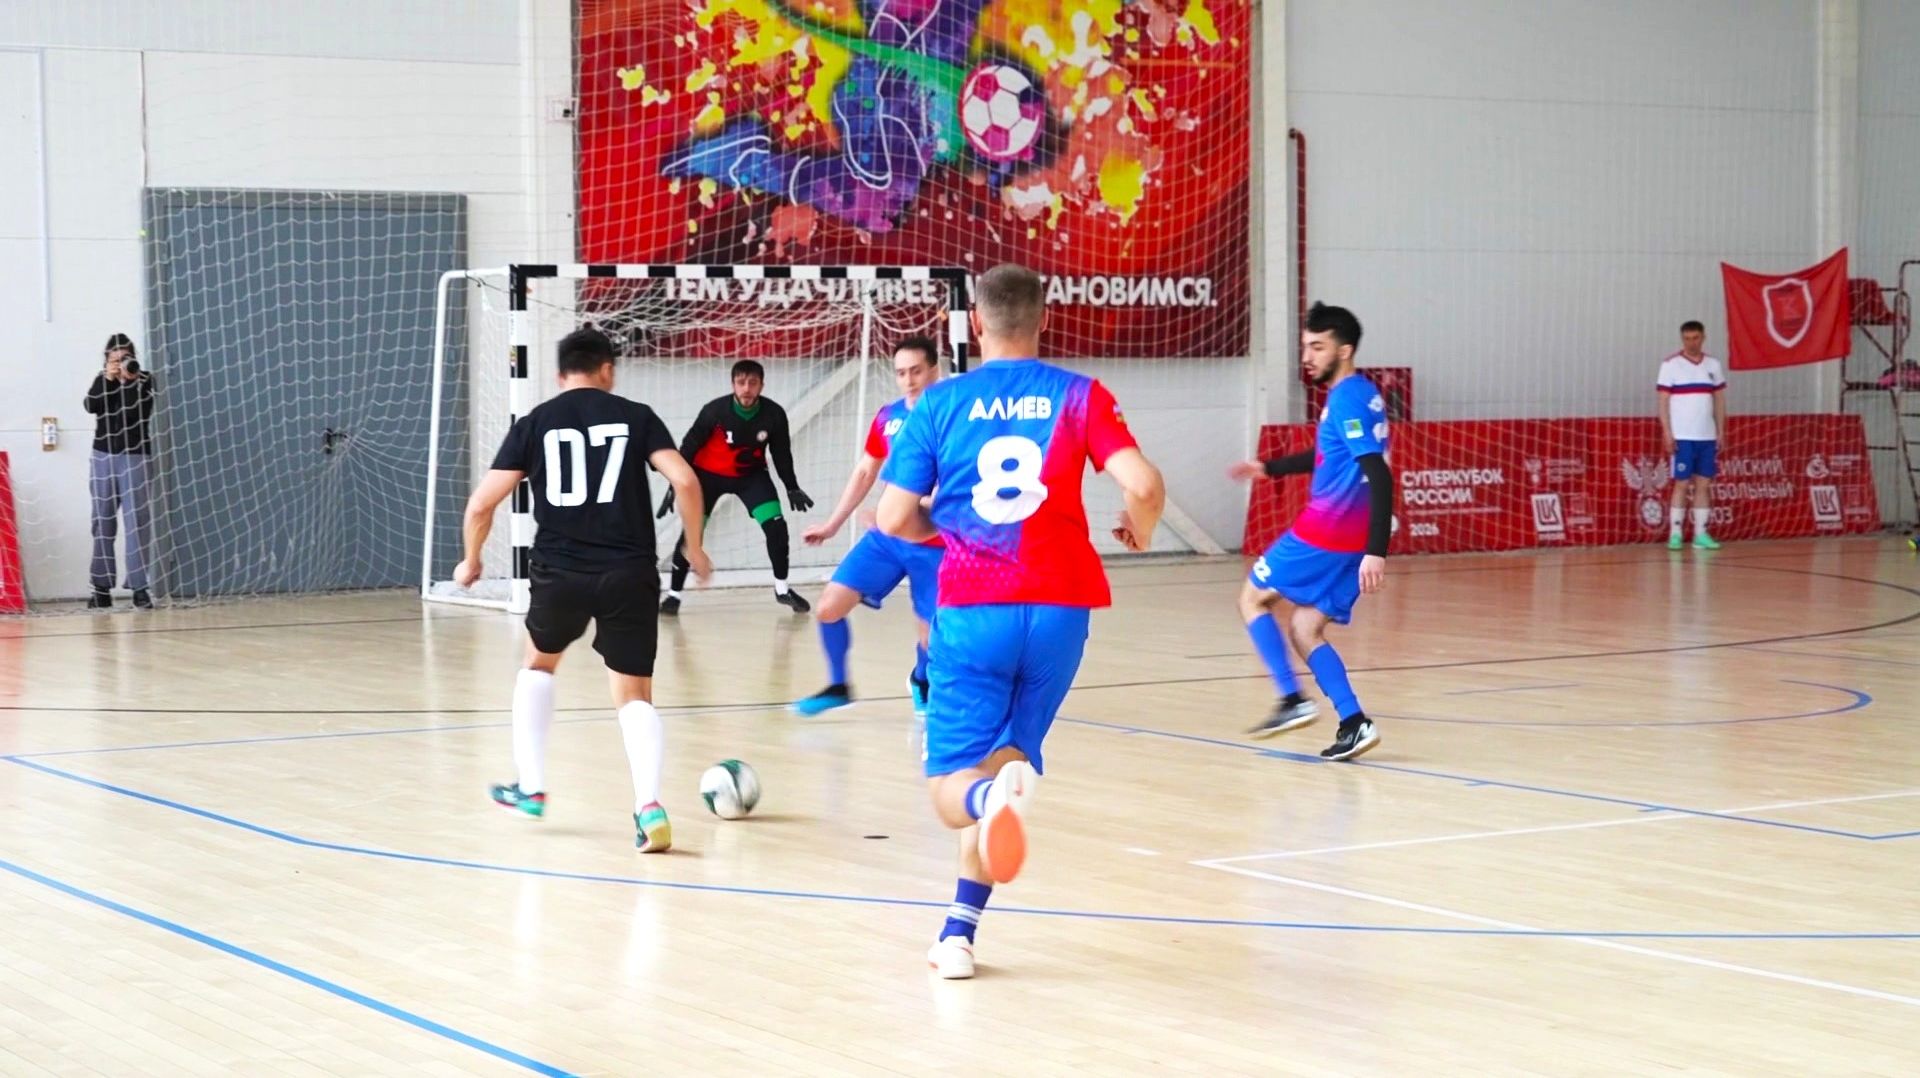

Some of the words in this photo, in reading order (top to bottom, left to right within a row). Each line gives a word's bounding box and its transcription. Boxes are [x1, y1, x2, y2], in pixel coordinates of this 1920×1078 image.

[968, 396, 1052, 421] АЛИЕВ
[726, 430, 734, 444] 1
[543, 423, 629, 507] 07
[971, 435, 1049, 525] 8
[1401, 467, 1504, 487] СУПЕРКУБОК
[1403, 487, 1473, 505] РОССИИ
